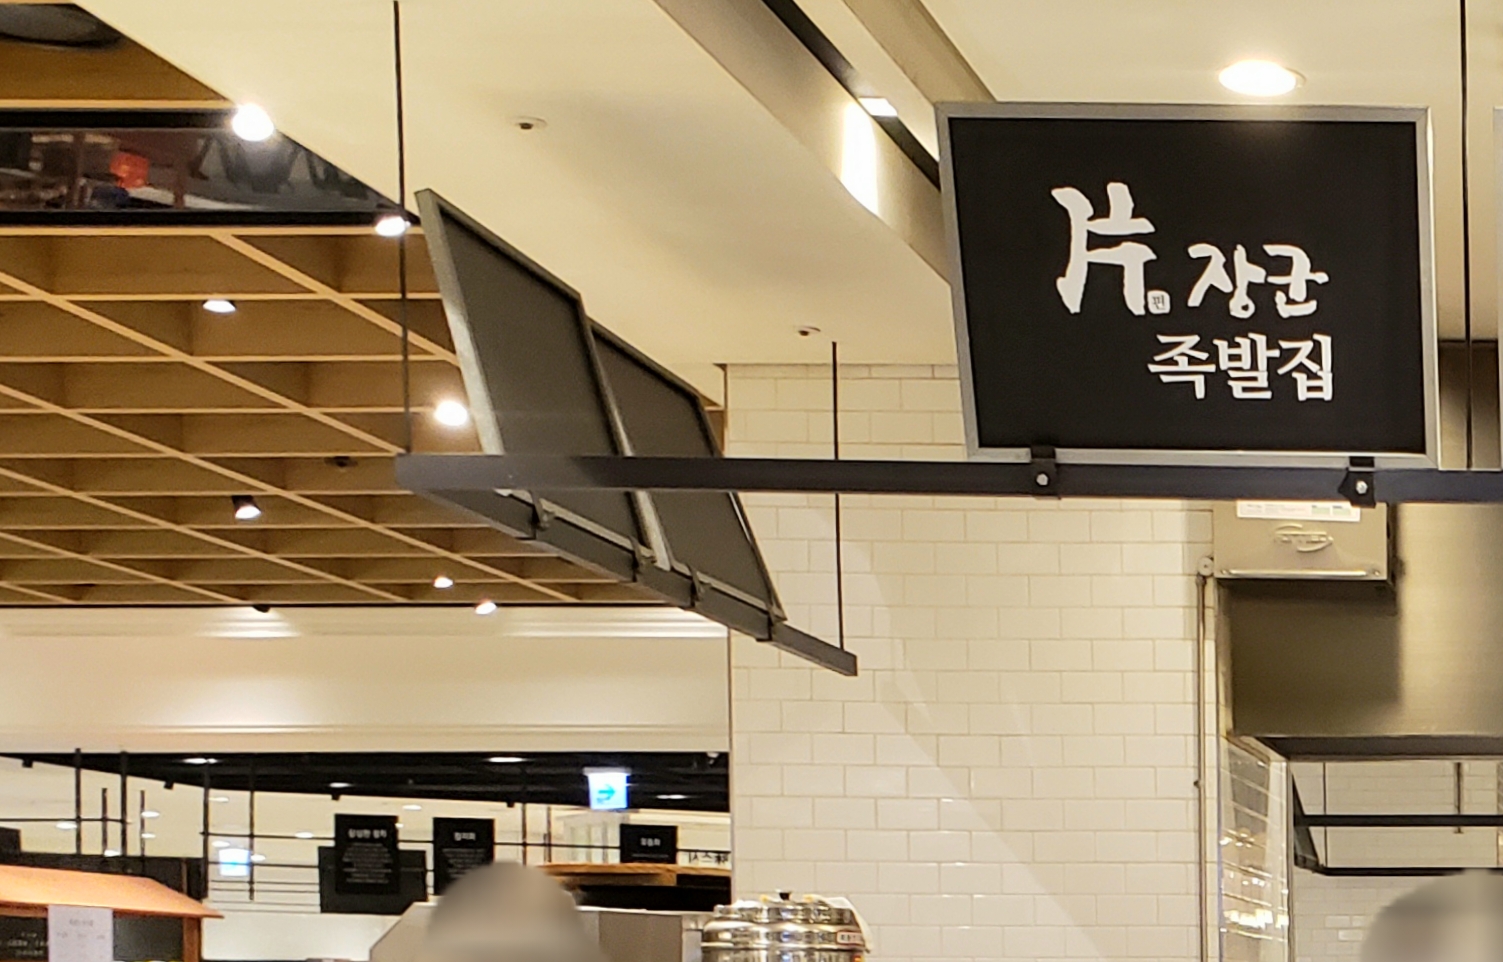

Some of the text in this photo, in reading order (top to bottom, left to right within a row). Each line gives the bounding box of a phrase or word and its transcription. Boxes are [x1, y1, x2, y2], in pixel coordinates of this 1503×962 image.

[1051, 181, 1157, 316] 片
[1187, 243, 1330, 319] 장군
[1146, 331, 1334, 402] 족발집
